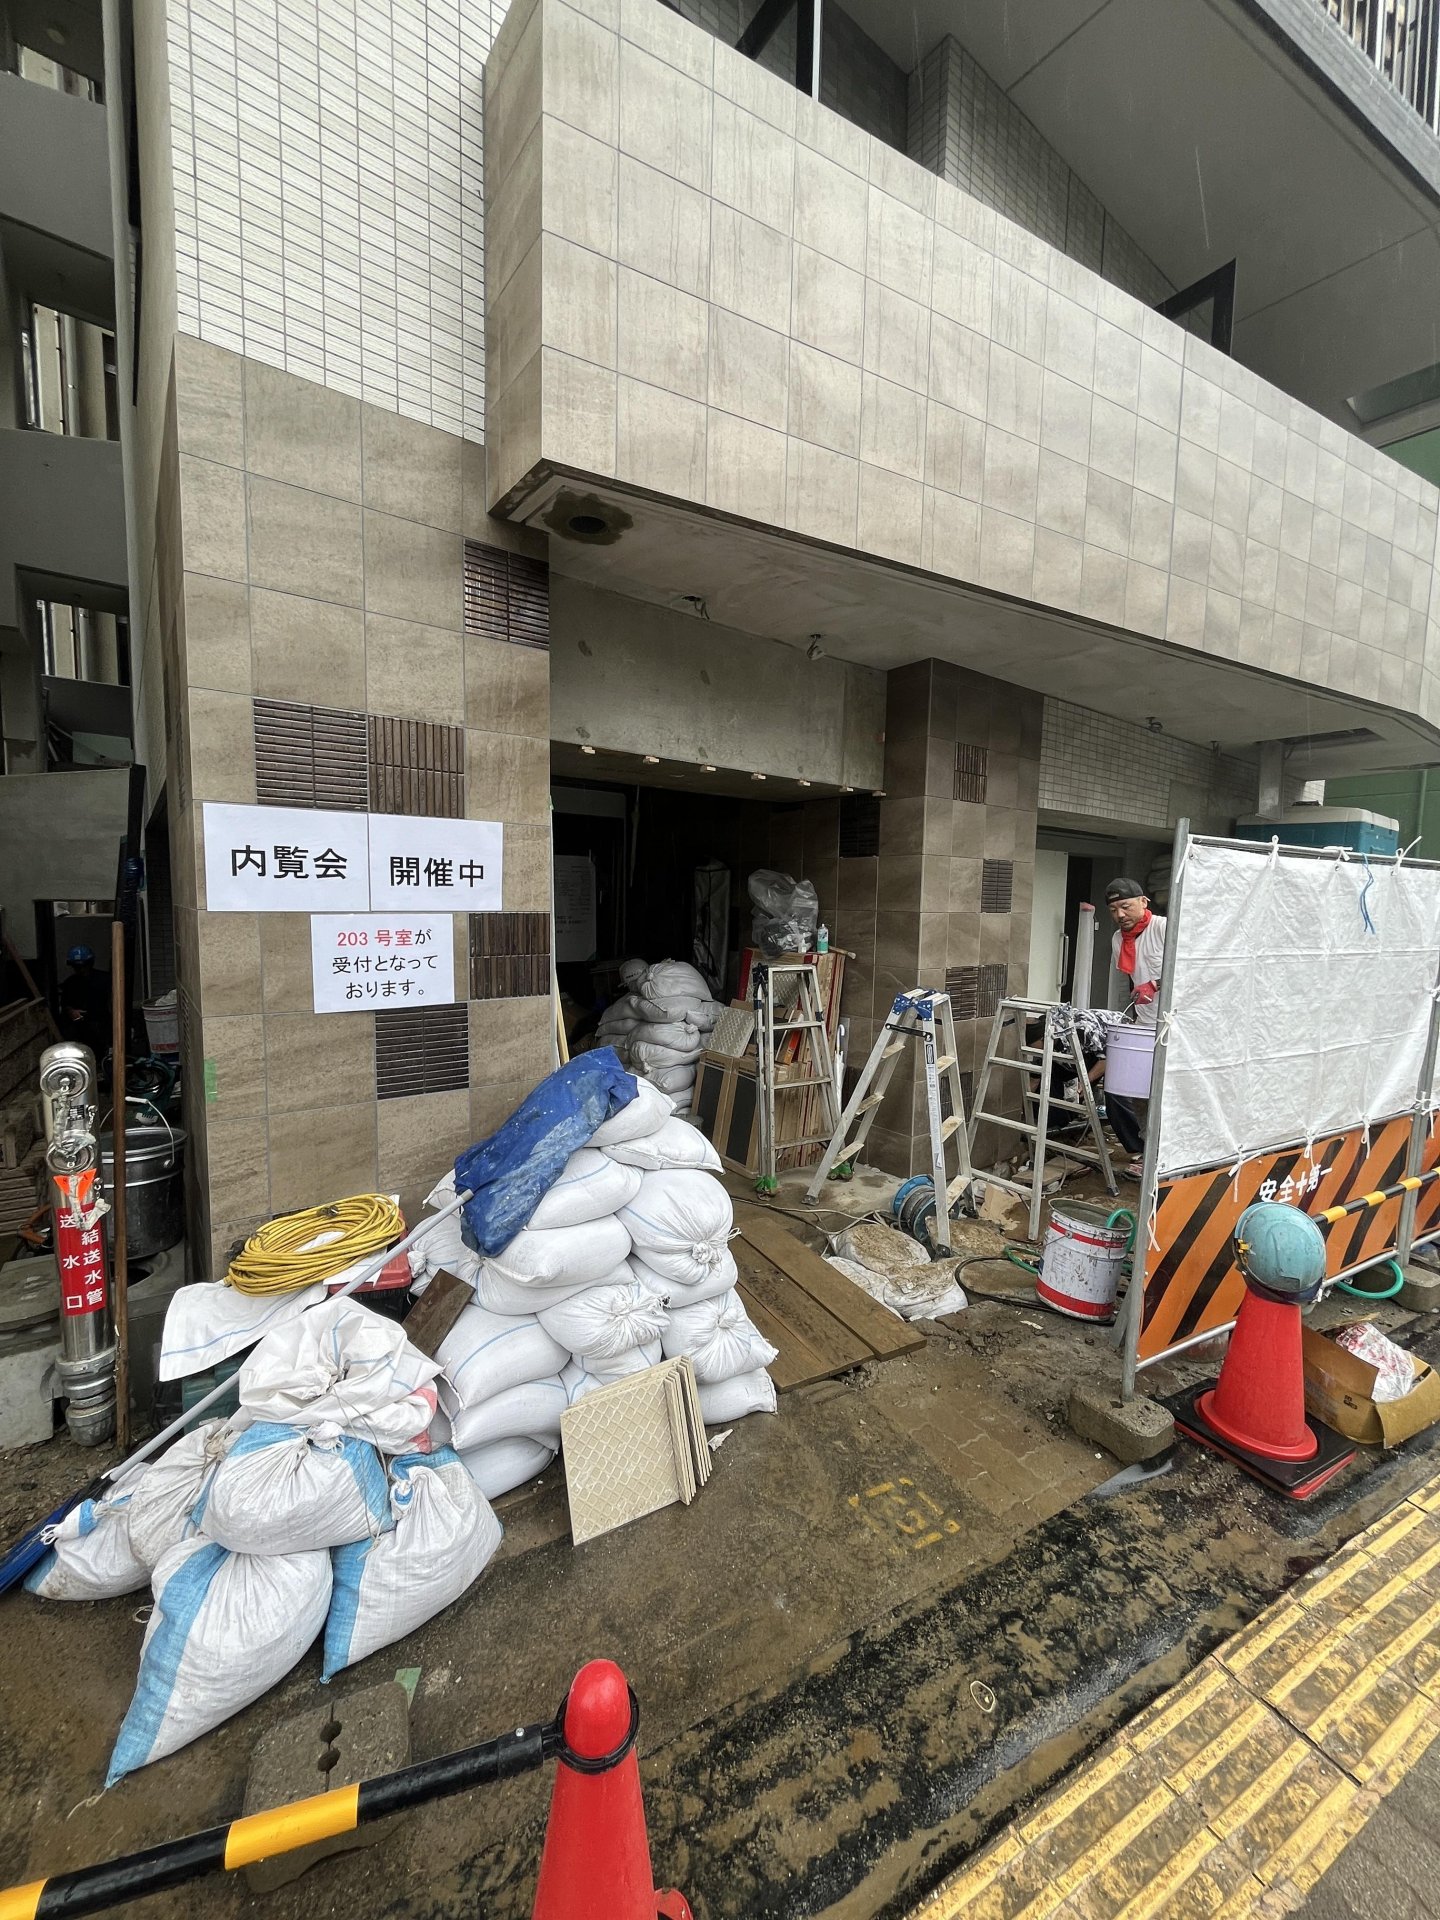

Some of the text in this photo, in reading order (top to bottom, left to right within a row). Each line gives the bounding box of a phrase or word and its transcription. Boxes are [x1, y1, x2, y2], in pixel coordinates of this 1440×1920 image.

[231, 844, 484, 888] 内覧会 開催中
[332, 954, 439, 975] 受付となって
[346, 978, 425, 1000] おります。
